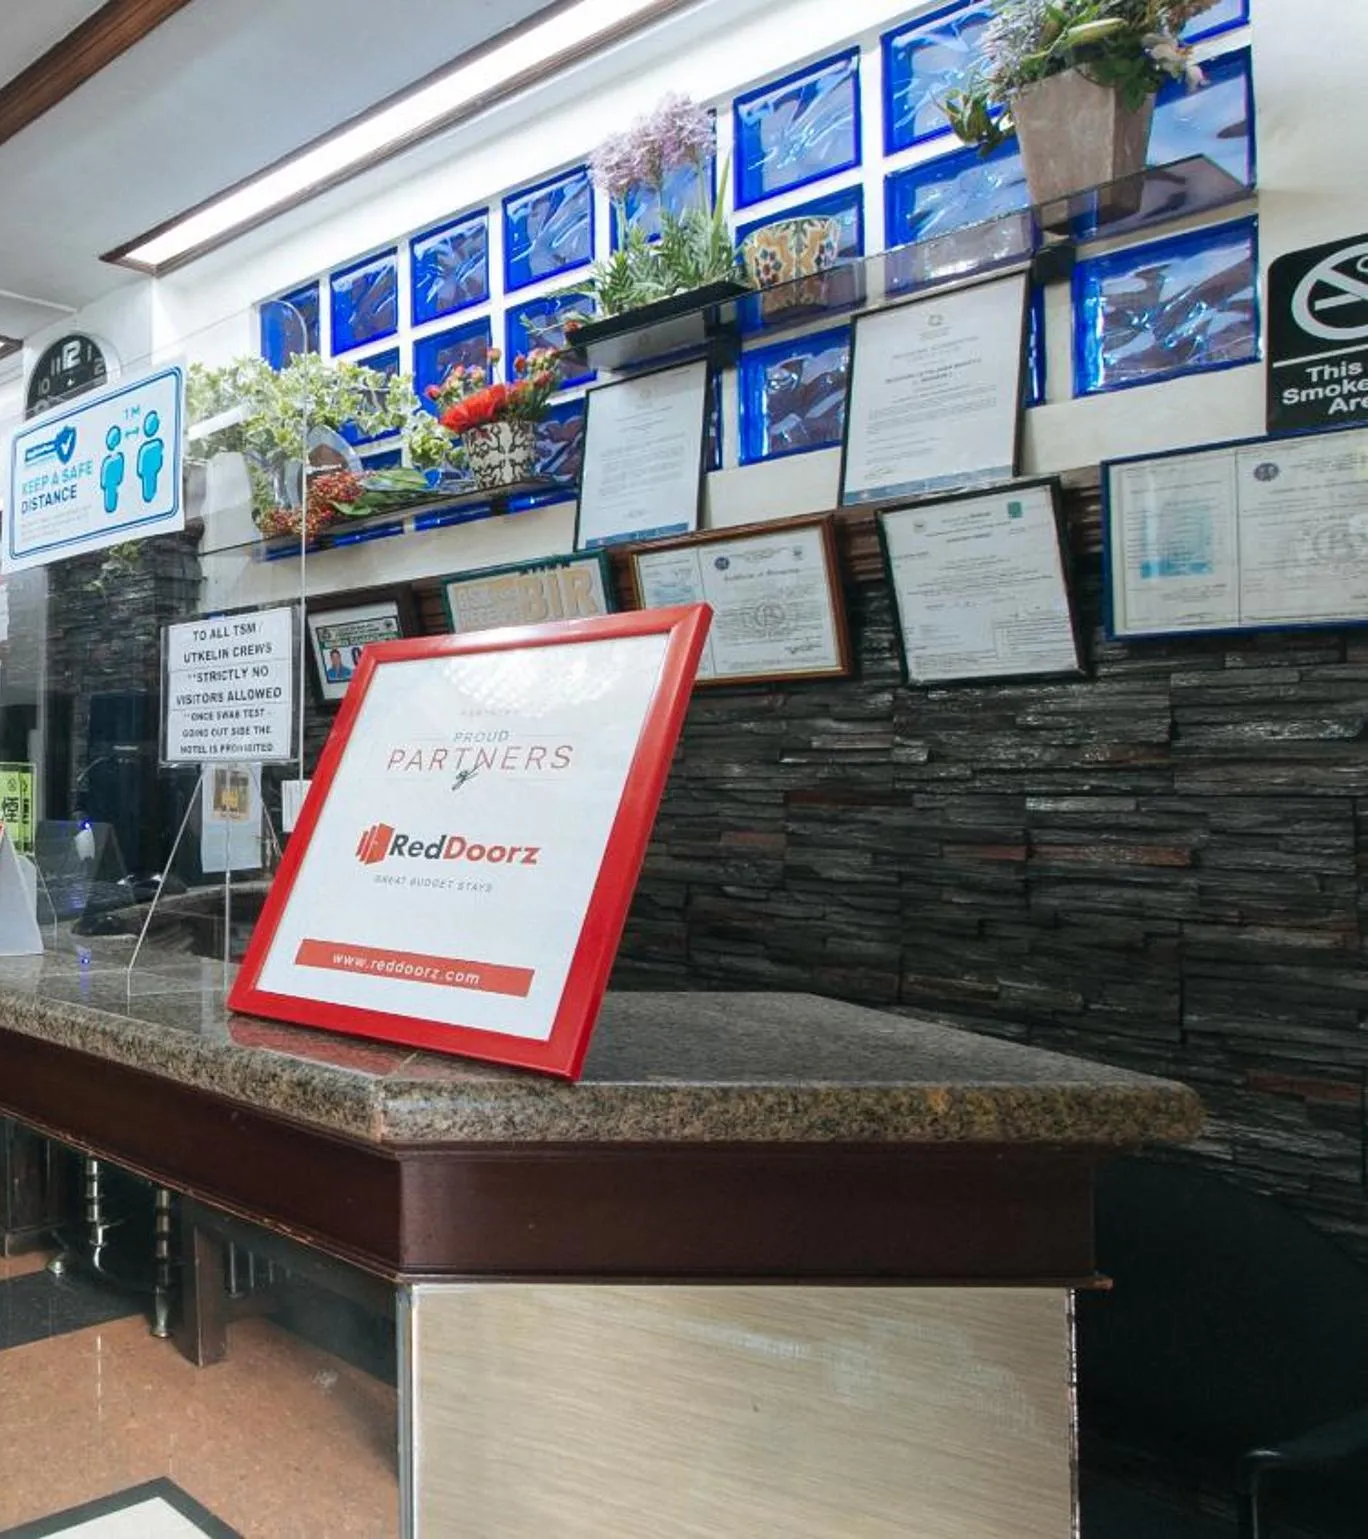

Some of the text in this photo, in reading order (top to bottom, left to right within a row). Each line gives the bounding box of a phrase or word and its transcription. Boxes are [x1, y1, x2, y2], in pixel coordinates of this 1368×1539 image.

[1306, 361, 1363, 382] This
[22, 460, 93, 494] KEEP A SAFE
[21, 485, 77, 515] DISTANCE
[193, 630, 207, 641] TO
[210, 627, 230, 639] ALL
[233, 623, 257, 637] TSM
[233, 642, 272, 658] CREWS
[252, 665, 269, 678] NO
[176, 687, 282, 705] VISITORS ALLOWED
[243, 708, 265, 719] TEST
[211, 727, 229, 738] OUT
[232, 726, 250, 736] SIDE
[253, 725, 272, 735] THE
[453, 730, 510, 743] PROUD
[209, 745, 218, 754] IS
[387, 744, 574, 772] PARTNERS
[388, 834, 541, 865] RedDoorz
[409, 877, 453, 889] BUDGET
[456, 881, 493, 893] STAYS
[332, 952, 481, 986] www.reddoorz.com
